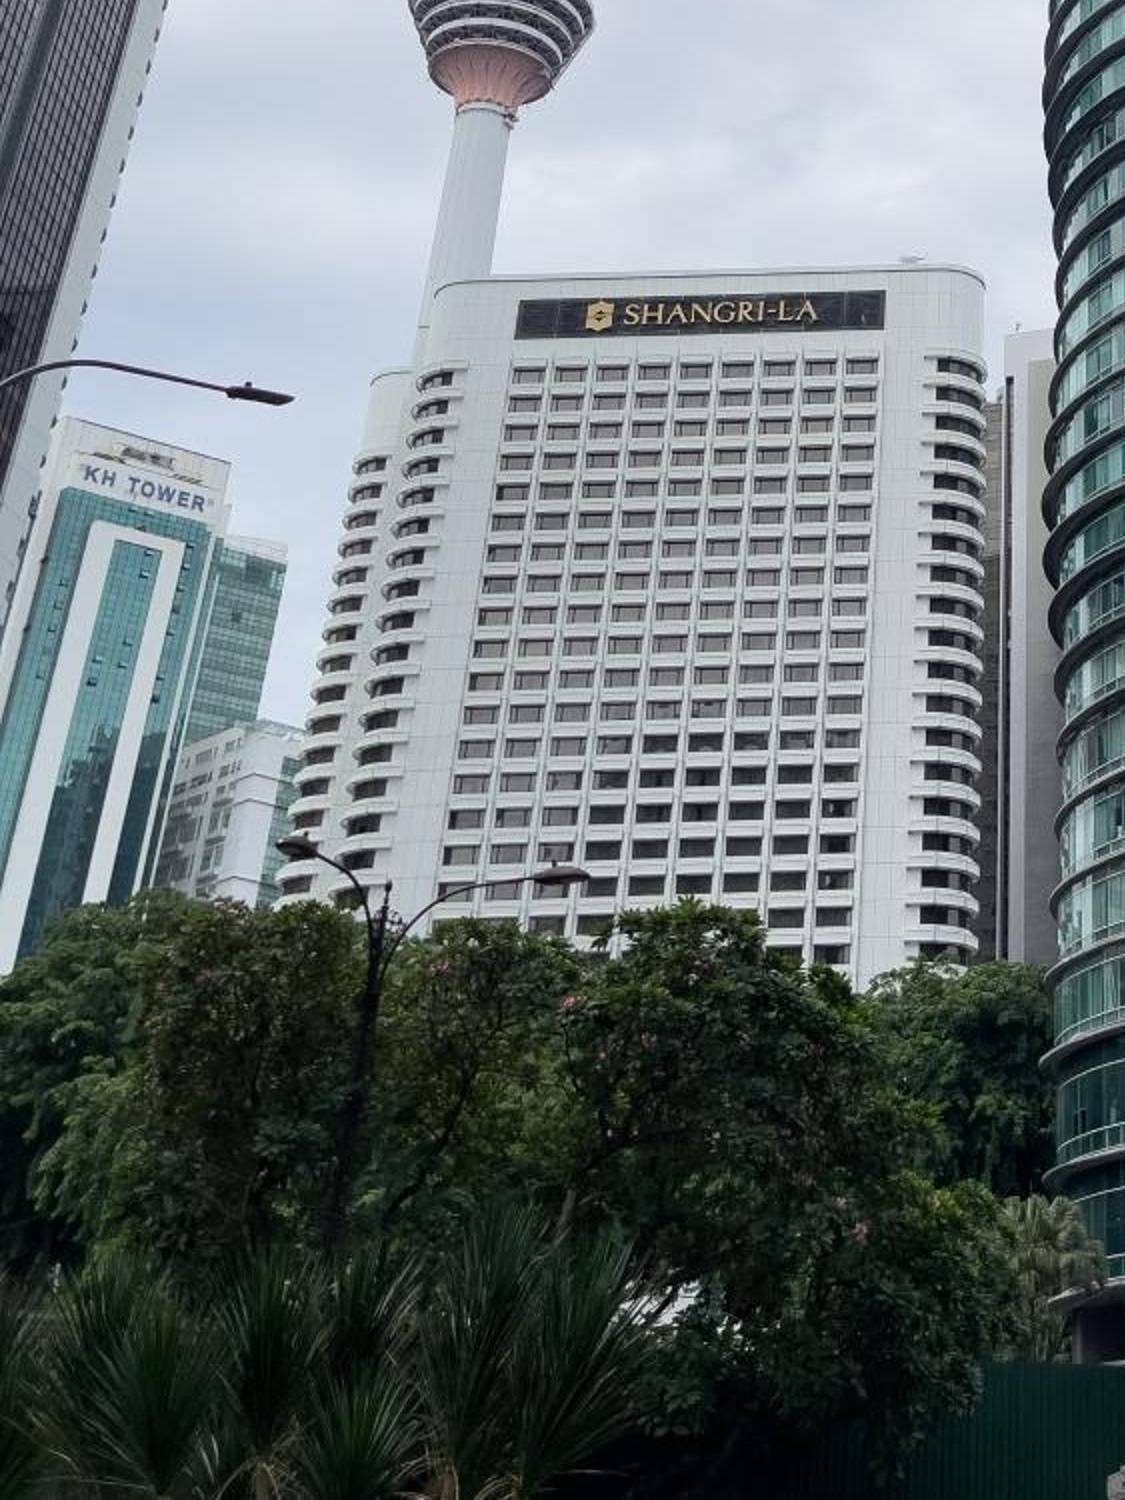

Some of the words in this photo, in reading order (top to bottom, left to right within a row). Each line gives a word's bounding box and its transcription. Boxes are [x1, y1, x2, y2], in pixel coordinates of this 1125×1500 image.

[623, 301, 819, 326] SHANGRI-LA
[83, 464, 117, 488] KH
[127, 476, 206, 513] TOWER
